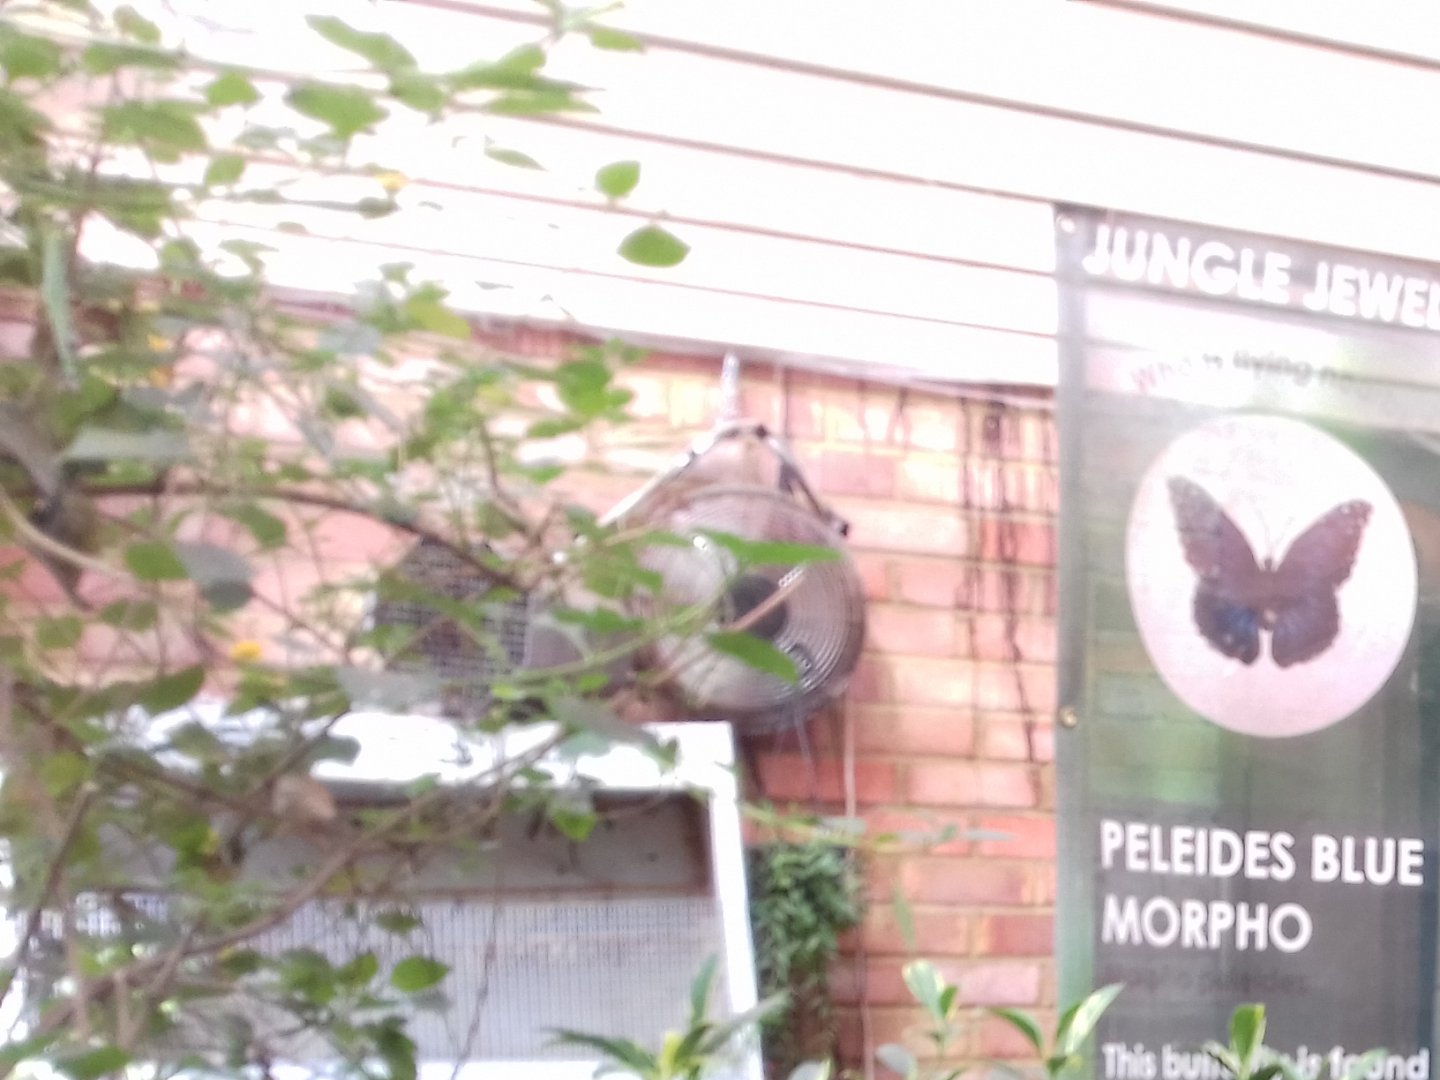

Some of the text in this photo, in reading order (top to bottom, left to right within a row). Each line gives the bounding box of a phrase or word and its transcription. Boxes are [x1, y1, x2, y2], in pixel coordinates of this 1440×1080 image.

[1082, 223, 1292, 306] JUNGLE
[1100, 819, 1425, 886] PELEIDES BLUE
[1102, 894, 1313, 953] MORPHO
[1101, 1042, 1157, 1080] This
